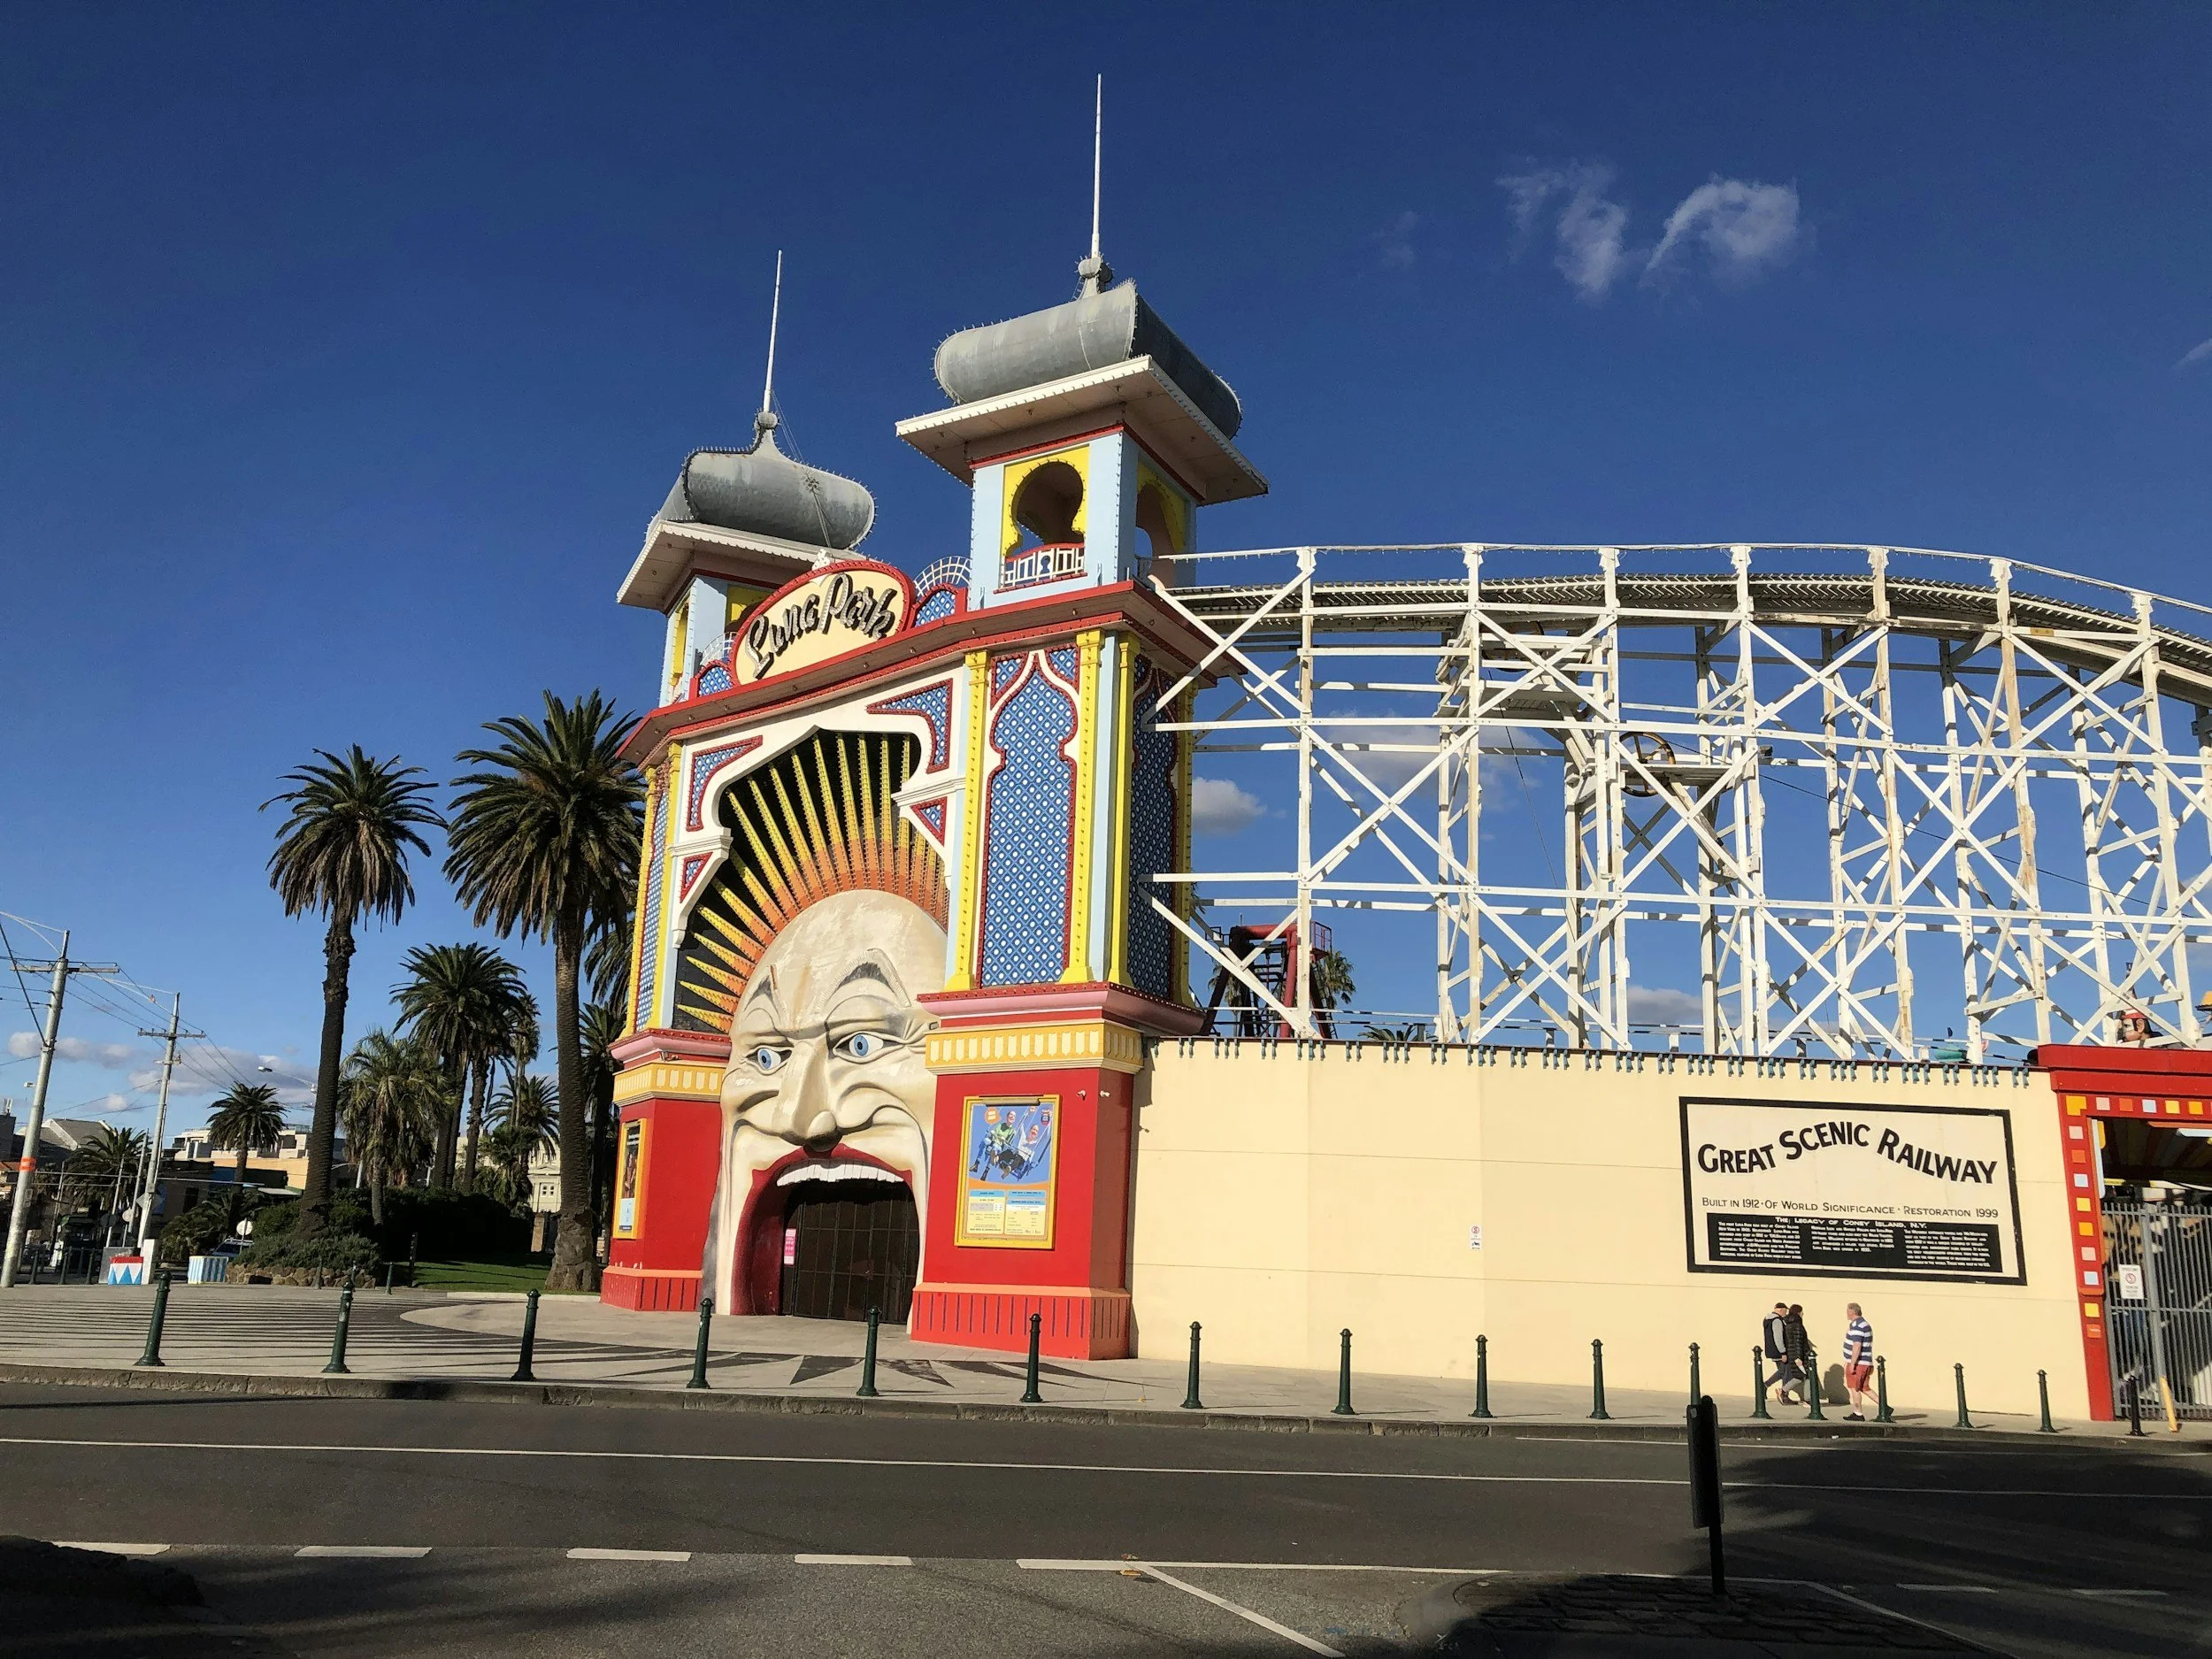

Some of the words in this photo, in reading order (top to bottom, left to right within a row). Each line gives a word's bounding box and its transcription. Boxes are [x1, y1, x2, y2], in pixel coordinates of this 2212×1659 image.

[745, 593, 821, 680] Luna
[818, 572, 897, 641] Park
[1697, 1143, 1776, 1173] GREAT
[1779, 1121, 1872, 1160] SCENIC
[1877, 1127, 1998, 1184] RAILWAY
[1702, 1197, 1728, 1208] BUILT
[1730, 1199, 1740, 1208] IN
[1781, 1200, 1819, 1212] WORLD
[1822, 1202, 1896, 1216] SIGNIFICANCE
[1903, 1205, 1971, 1218] RESTORATION
[1976, 1207, 2000, 1218] 1999
